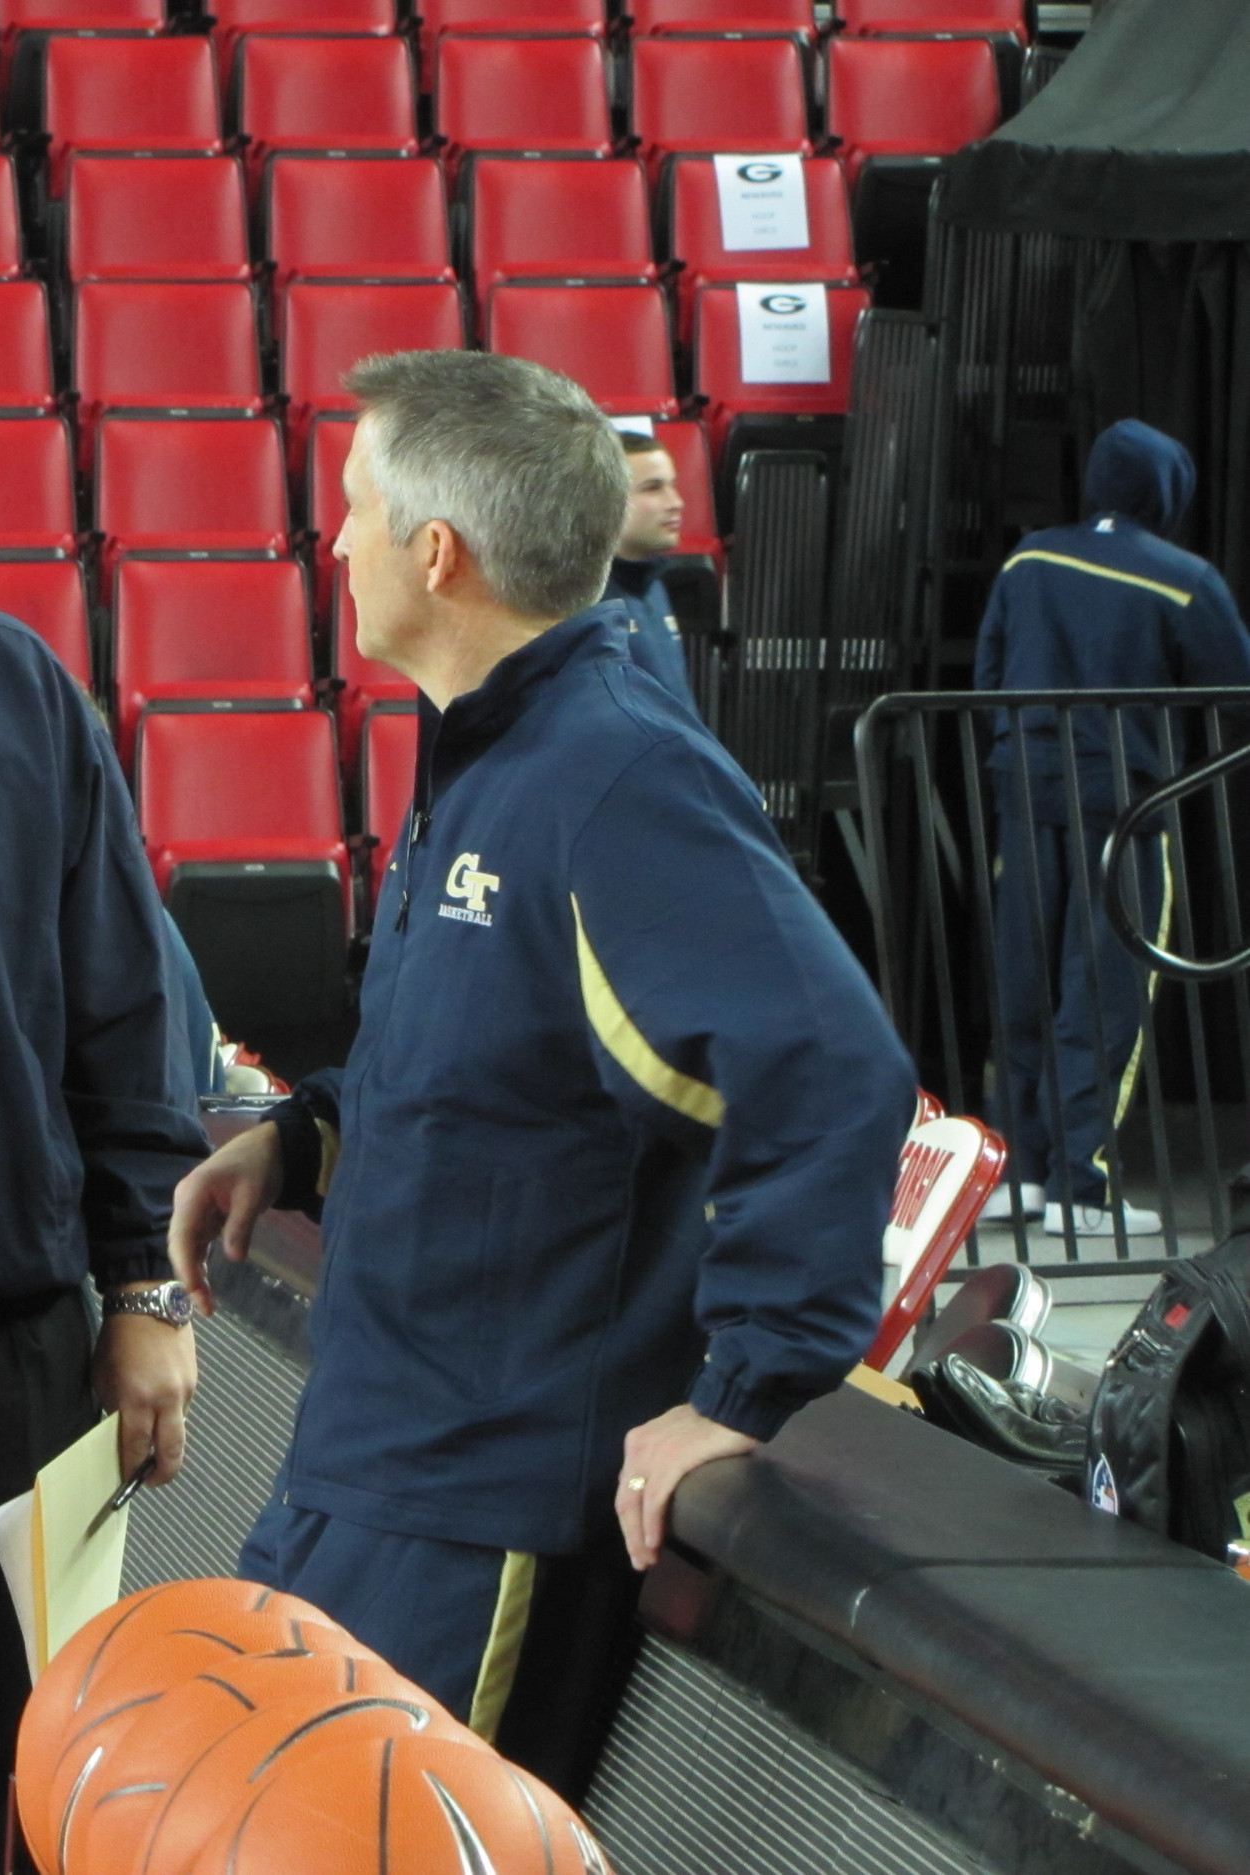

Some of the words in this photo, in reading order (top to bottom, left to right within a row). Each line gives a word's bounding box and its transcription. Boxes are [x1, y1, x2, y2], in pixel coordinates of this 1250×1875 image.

[736, 162, 783, 183] G
[759, 293, 807, 315] G
[446, 852, 500, 912] GT
[438, 903, 492, 927] BASKETBALL
